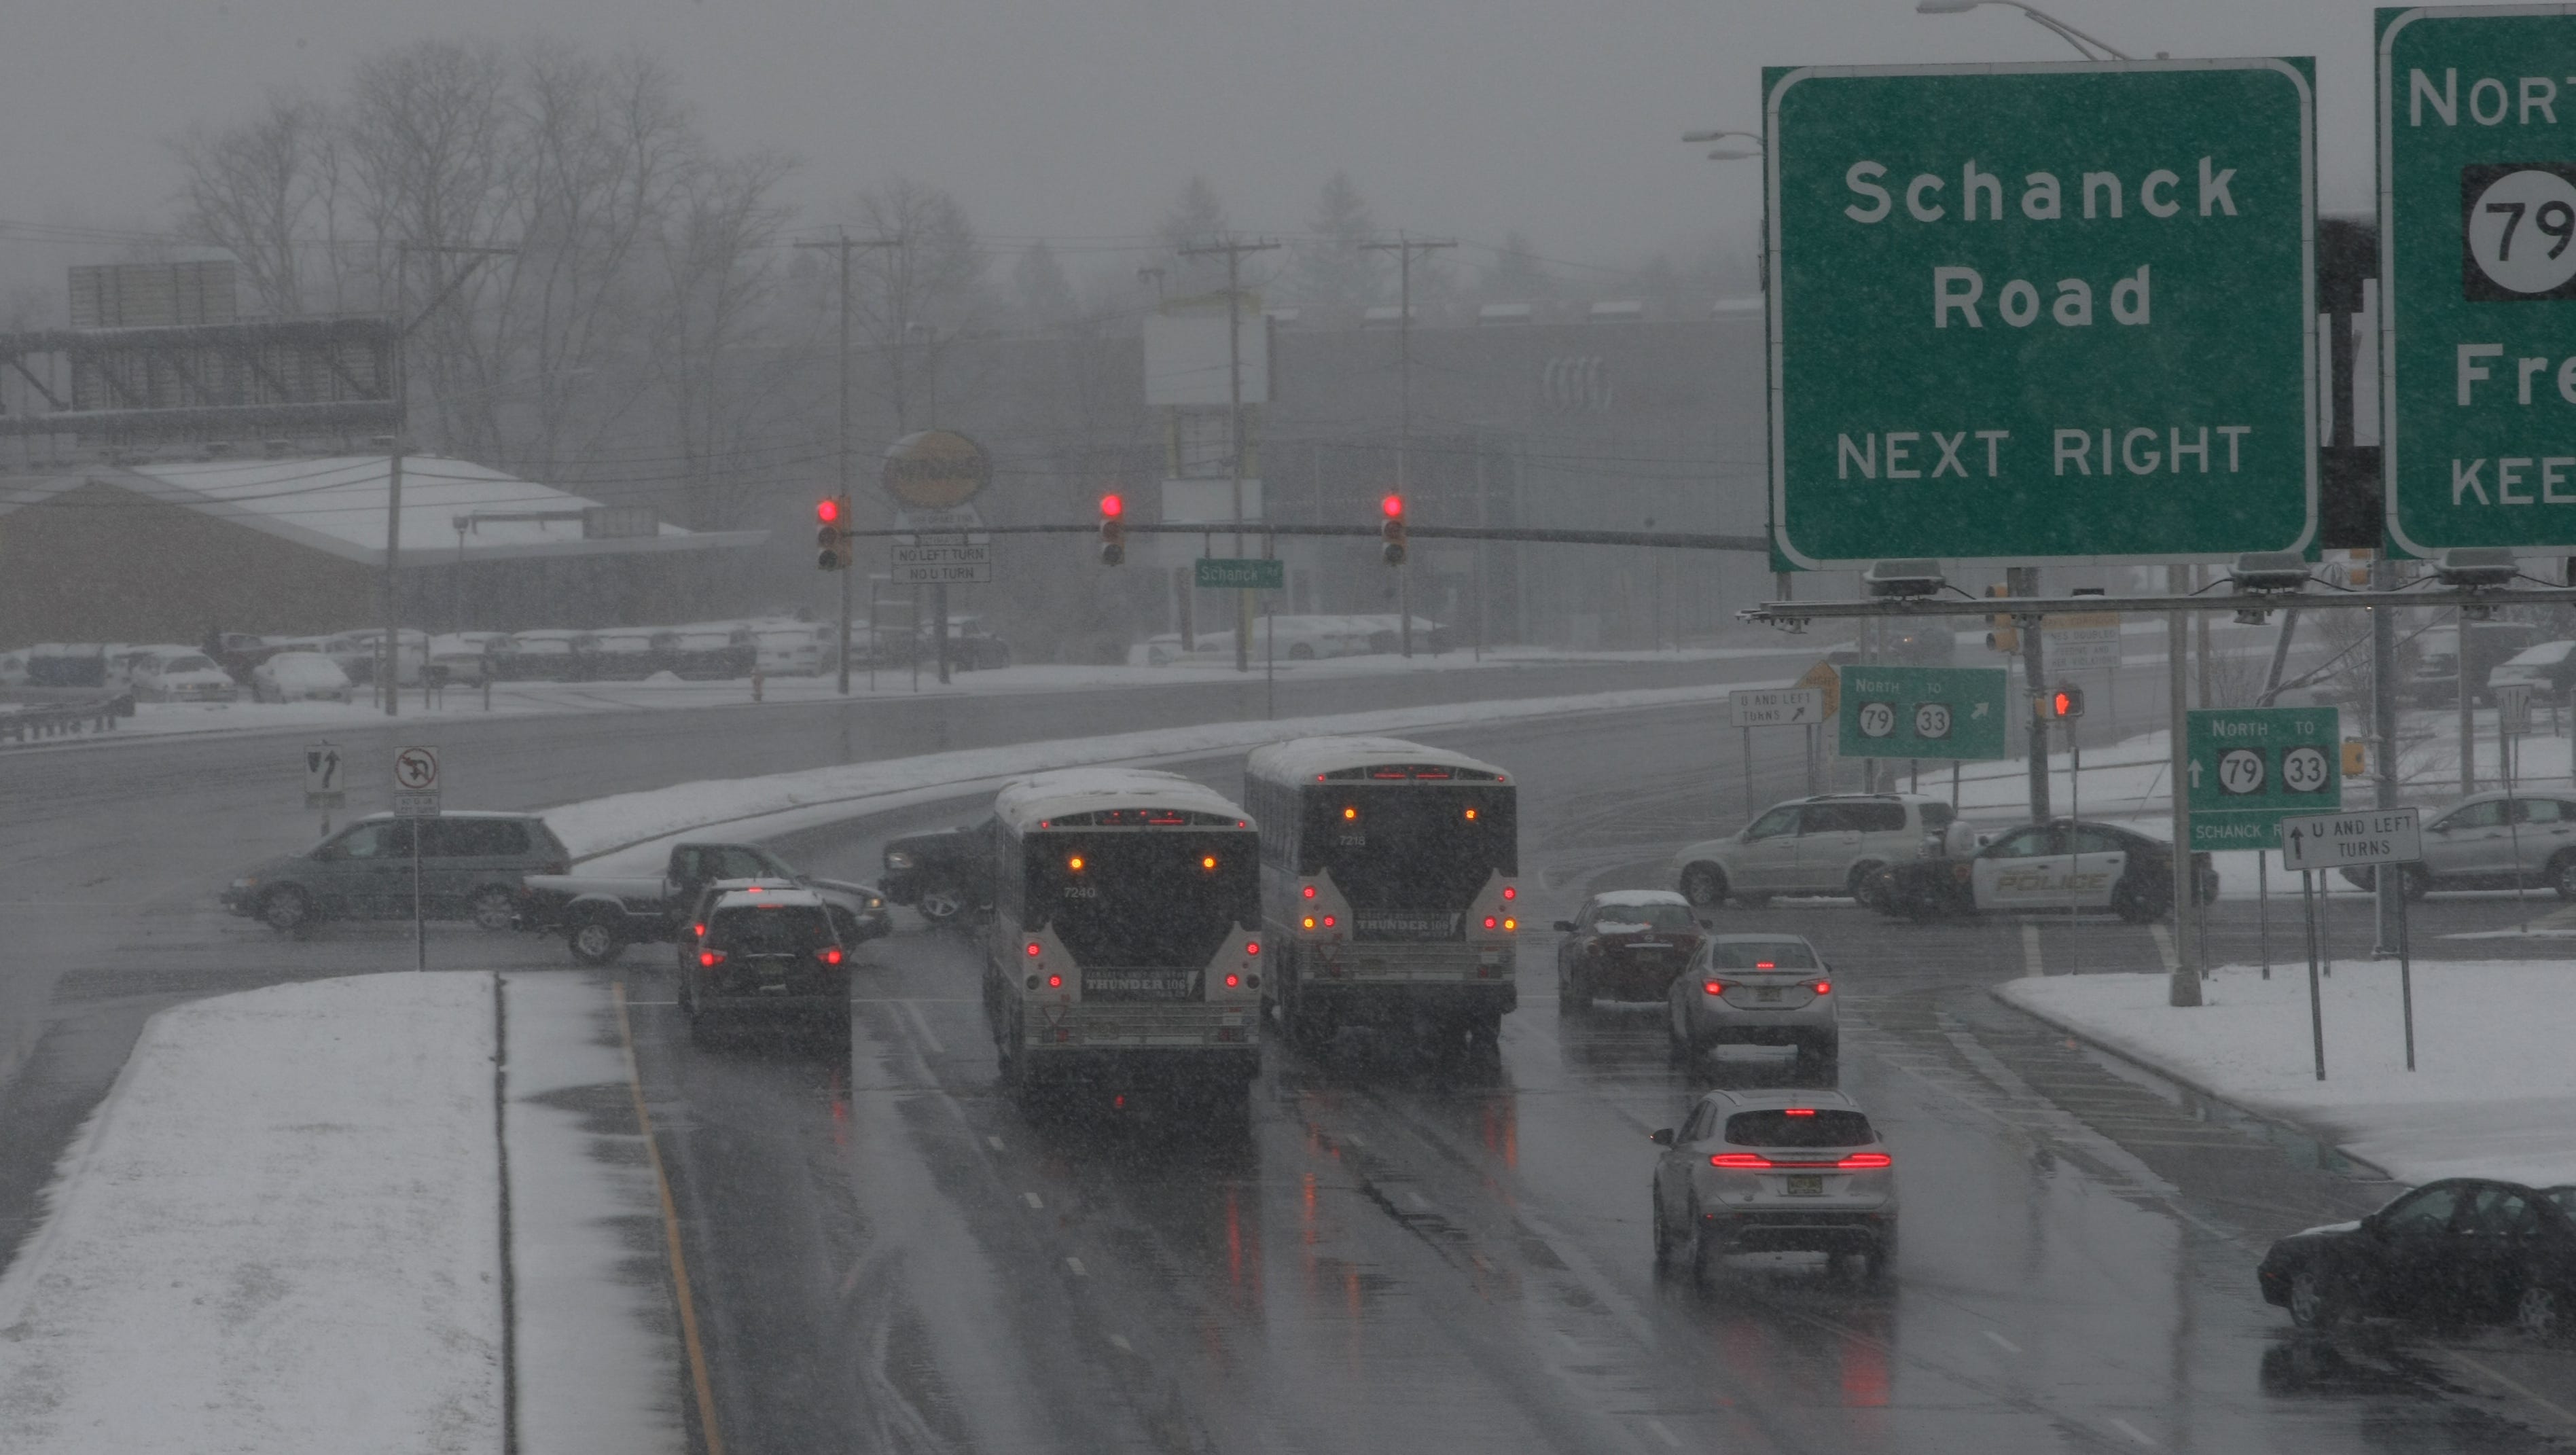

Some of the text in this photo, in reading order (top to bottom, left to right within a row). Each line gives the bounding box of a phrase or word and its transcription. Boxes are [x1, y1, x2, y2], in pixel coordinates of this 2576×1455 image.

[1844, 157, 2240, 224] Schanck
[2486, 202, 2576, 262] 79
[1933, 265, 2151, 329] Road
[1838, 427, 2251, 480] NEXT RIGHT
[2452, 456, 2576, 505] KEE
[899, 548, 984, 561] NO LEFT TURN
[910, 567, 974, 579] NO U TURN
[1201, 567, 1258, 581] Schanck
[1856, 679, 1941, 694] NORTH TO
[1740, 693, 1810, 706] U AND LEFT
[1744, 711, 1781, 722] TURNS
[1865, 710, 1889, 730] 79
[1920, 711, 1946, 731] 33
[2213, 720, 2314, 736] NORTH TO
[2227, 758, 2257, 784] 79
[2290, 757, 2321, 783] 33
[2196, 824, 2262, 838] SCHANCK
[2312, 816, 2412, 838] U AND LEFT
[2339, 840, 2391, 858] TURNS
[1996, 873, 2109, 892] POLICE
[1064, 887, 1096, 899] 7240
[1357, 919, 1450, 931] THUNDER 106
[1086, 978, 1185, 990] THUNDER 106
